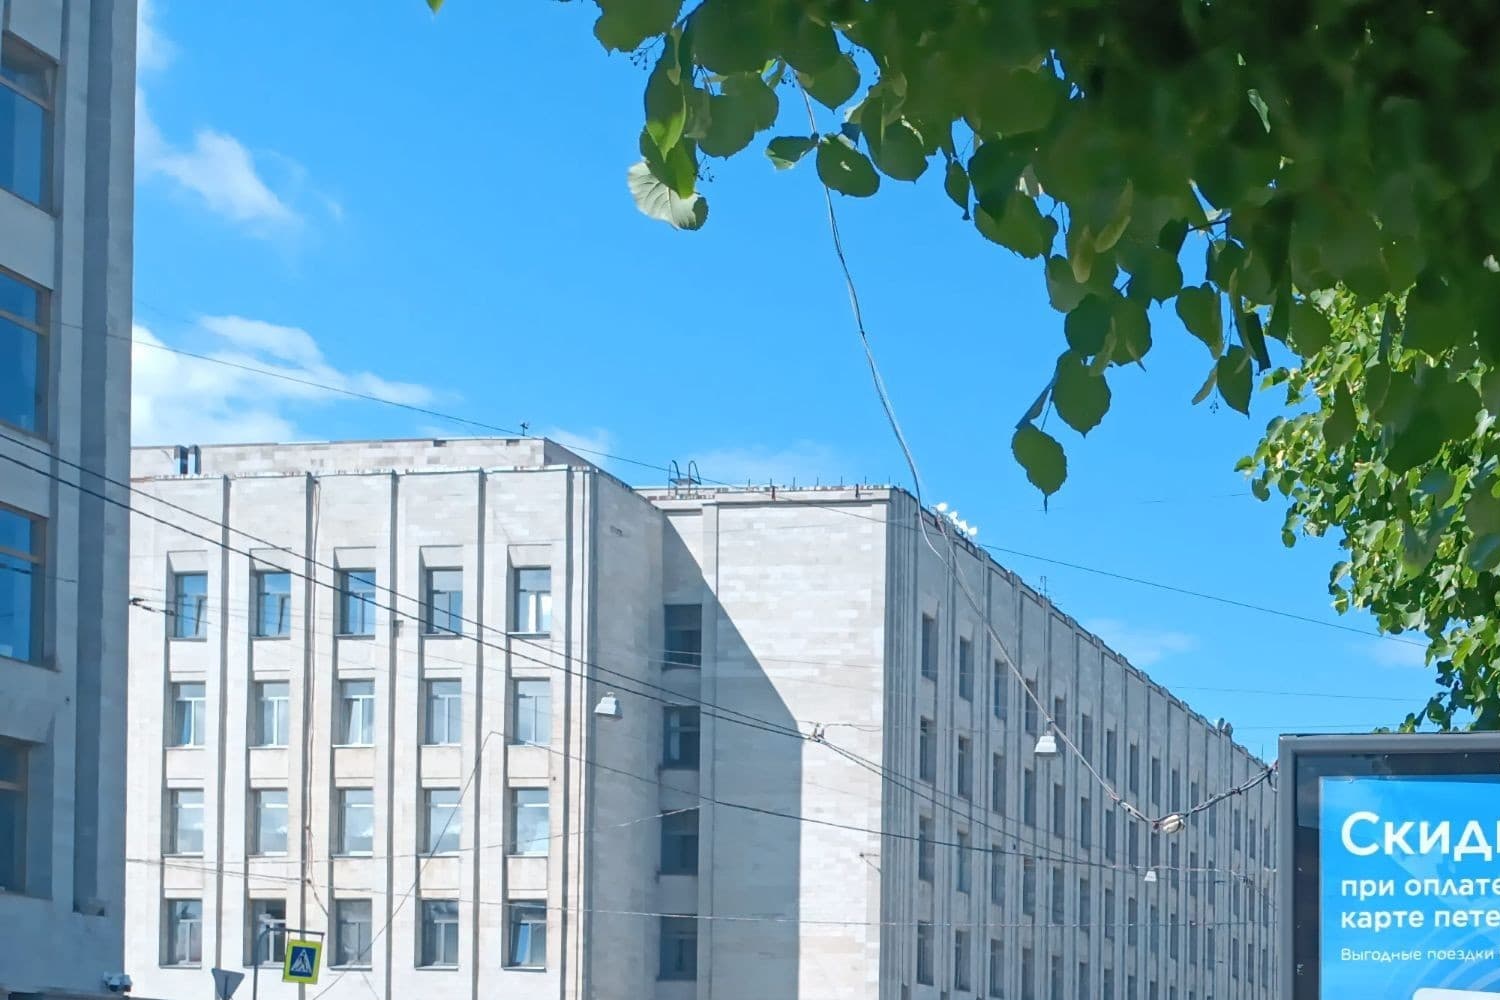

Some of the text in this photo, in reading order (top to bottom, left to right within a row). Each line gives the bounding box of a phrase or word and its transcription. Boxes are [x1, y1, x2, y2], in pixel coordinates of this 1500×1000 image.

[1341, 879, 1395, 901] при
[1341, 910, 1425, 932] карте
[1341, 948, 1422, 962] Выгодные
[1427, 950, 1494, 963] поездки
